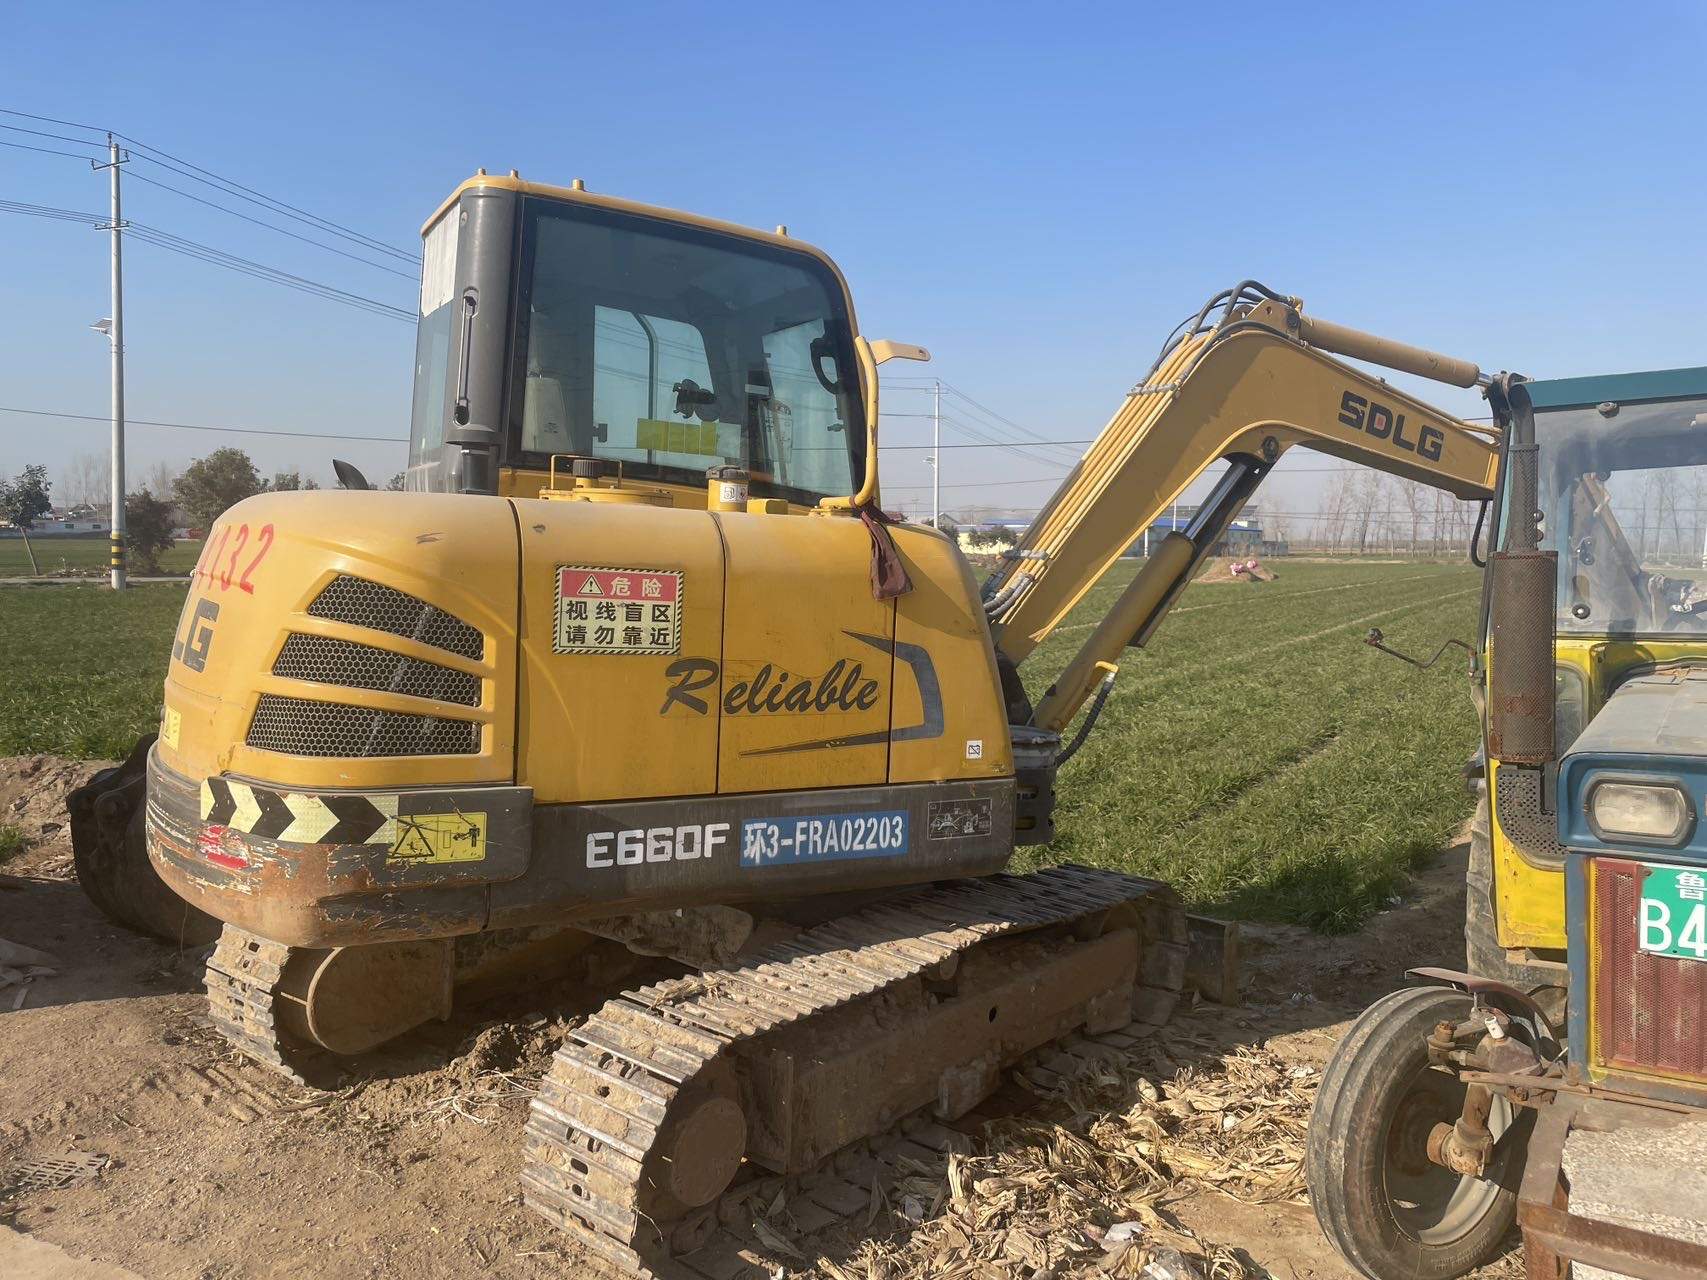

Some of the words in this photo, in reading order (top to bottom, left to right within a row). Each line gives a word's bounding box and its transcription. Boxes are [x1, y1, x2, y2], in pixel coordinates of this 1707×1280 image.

[1338, 390, 1444, 462] SDLG
[610, 576, 662, 598] 危险
[566, 600, 671, 623] 视线盲区
[565, 625, 670, 646] 请勿靠近
[660, 657, 878, 715] Reliable
[586, 823, 730, 868] E660F
[743, 815, 903, 864] 环3-FRA02203
[1675, 871, 1707, 901] 鲁
[1640, 898, 1707, 957] B4
